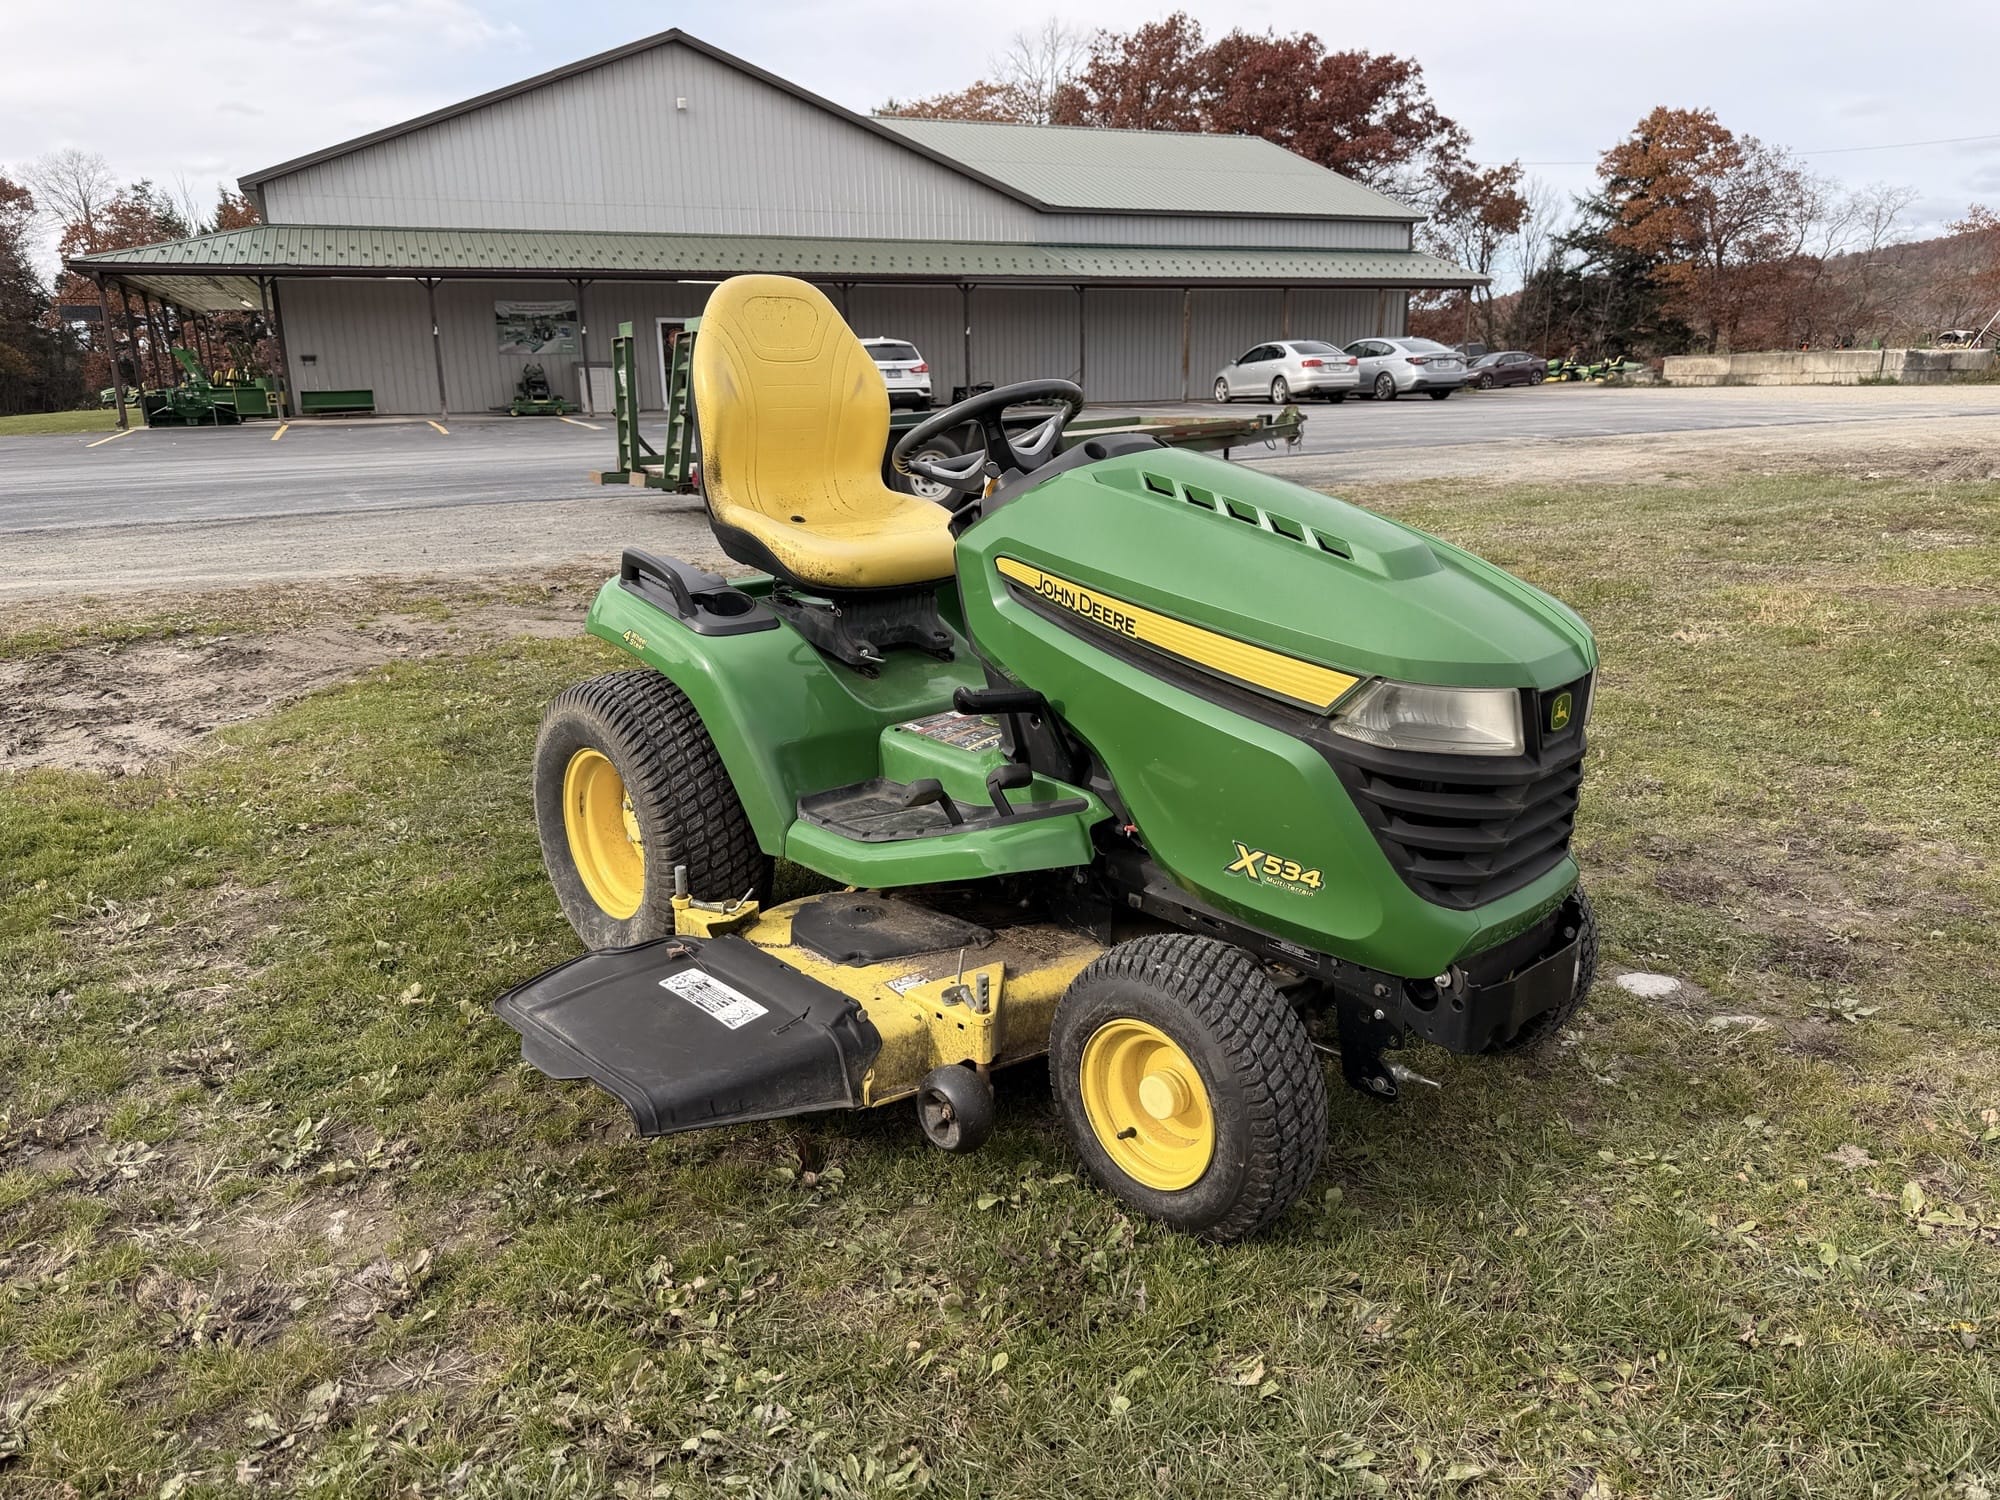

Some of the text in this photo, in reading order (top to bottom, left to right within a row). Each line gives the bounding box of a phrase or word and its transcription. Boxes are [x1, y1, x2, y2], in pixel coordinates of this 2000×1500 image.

[1034, 573, 1137, 635] JOHN DEERE
[623, 630, 632, 642] 4
[1226, 842, 1323, 889] X534
[1265, 876, 1315, 897] Multi-Terrain
